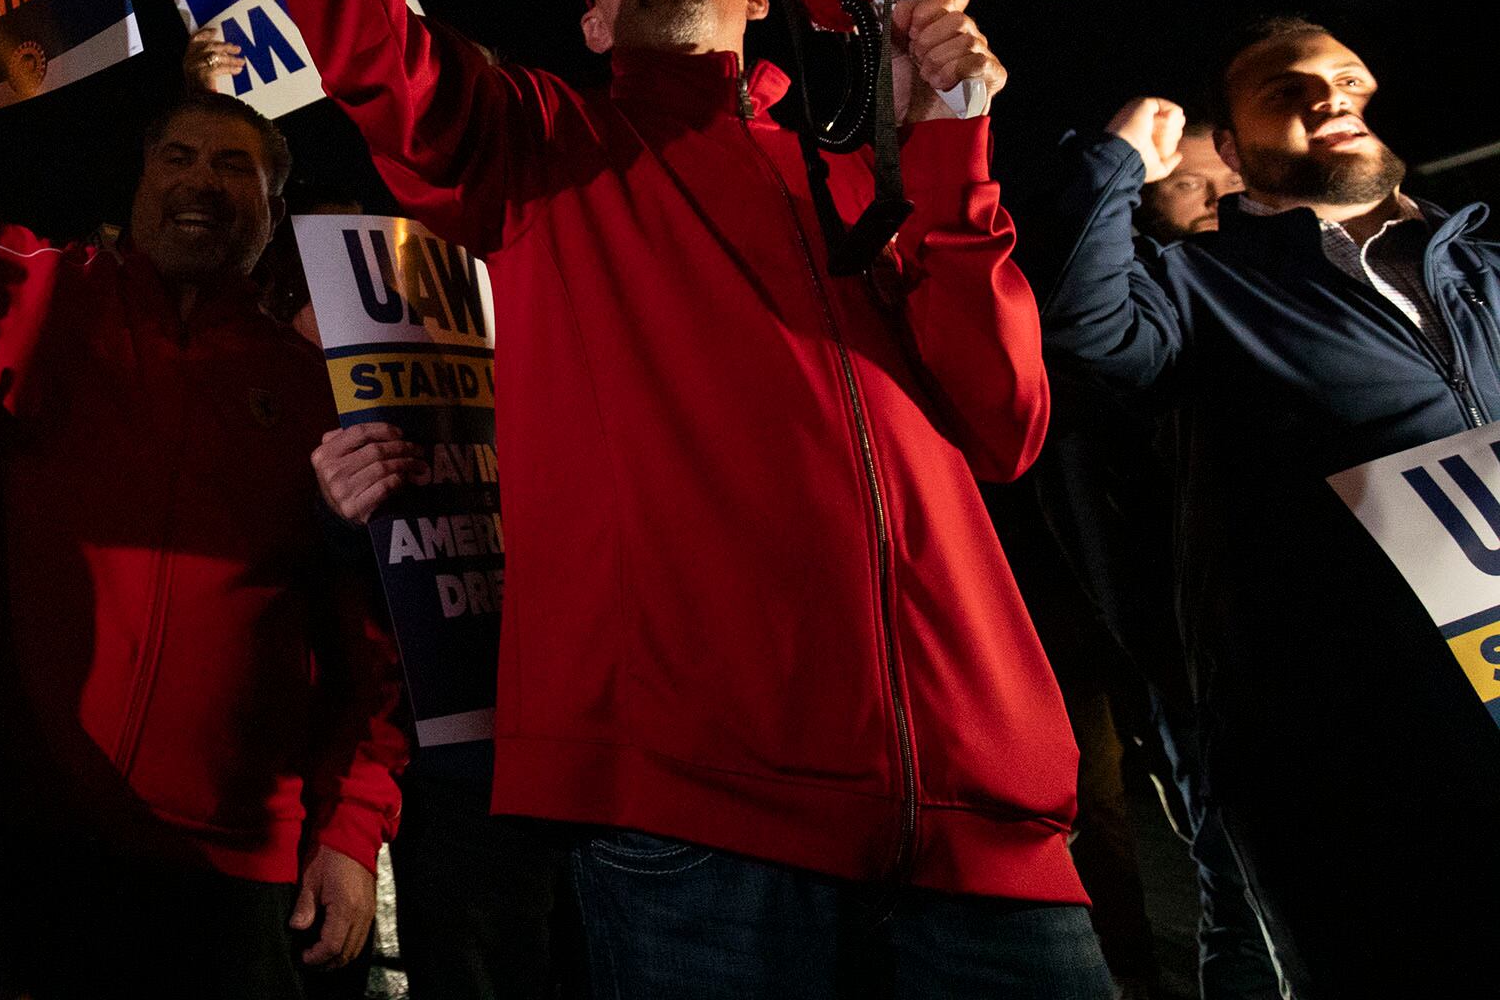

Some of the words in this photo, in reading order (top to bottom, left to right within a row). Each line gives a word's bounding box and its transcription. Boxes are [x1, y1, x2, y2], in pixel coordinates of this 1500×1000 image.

[342, 229, 487, 338] UAW
[350, 361, 479, 400] STAND
[388, 512, 505, 565] AMERI
[435, 570, 503, 619] DRE
